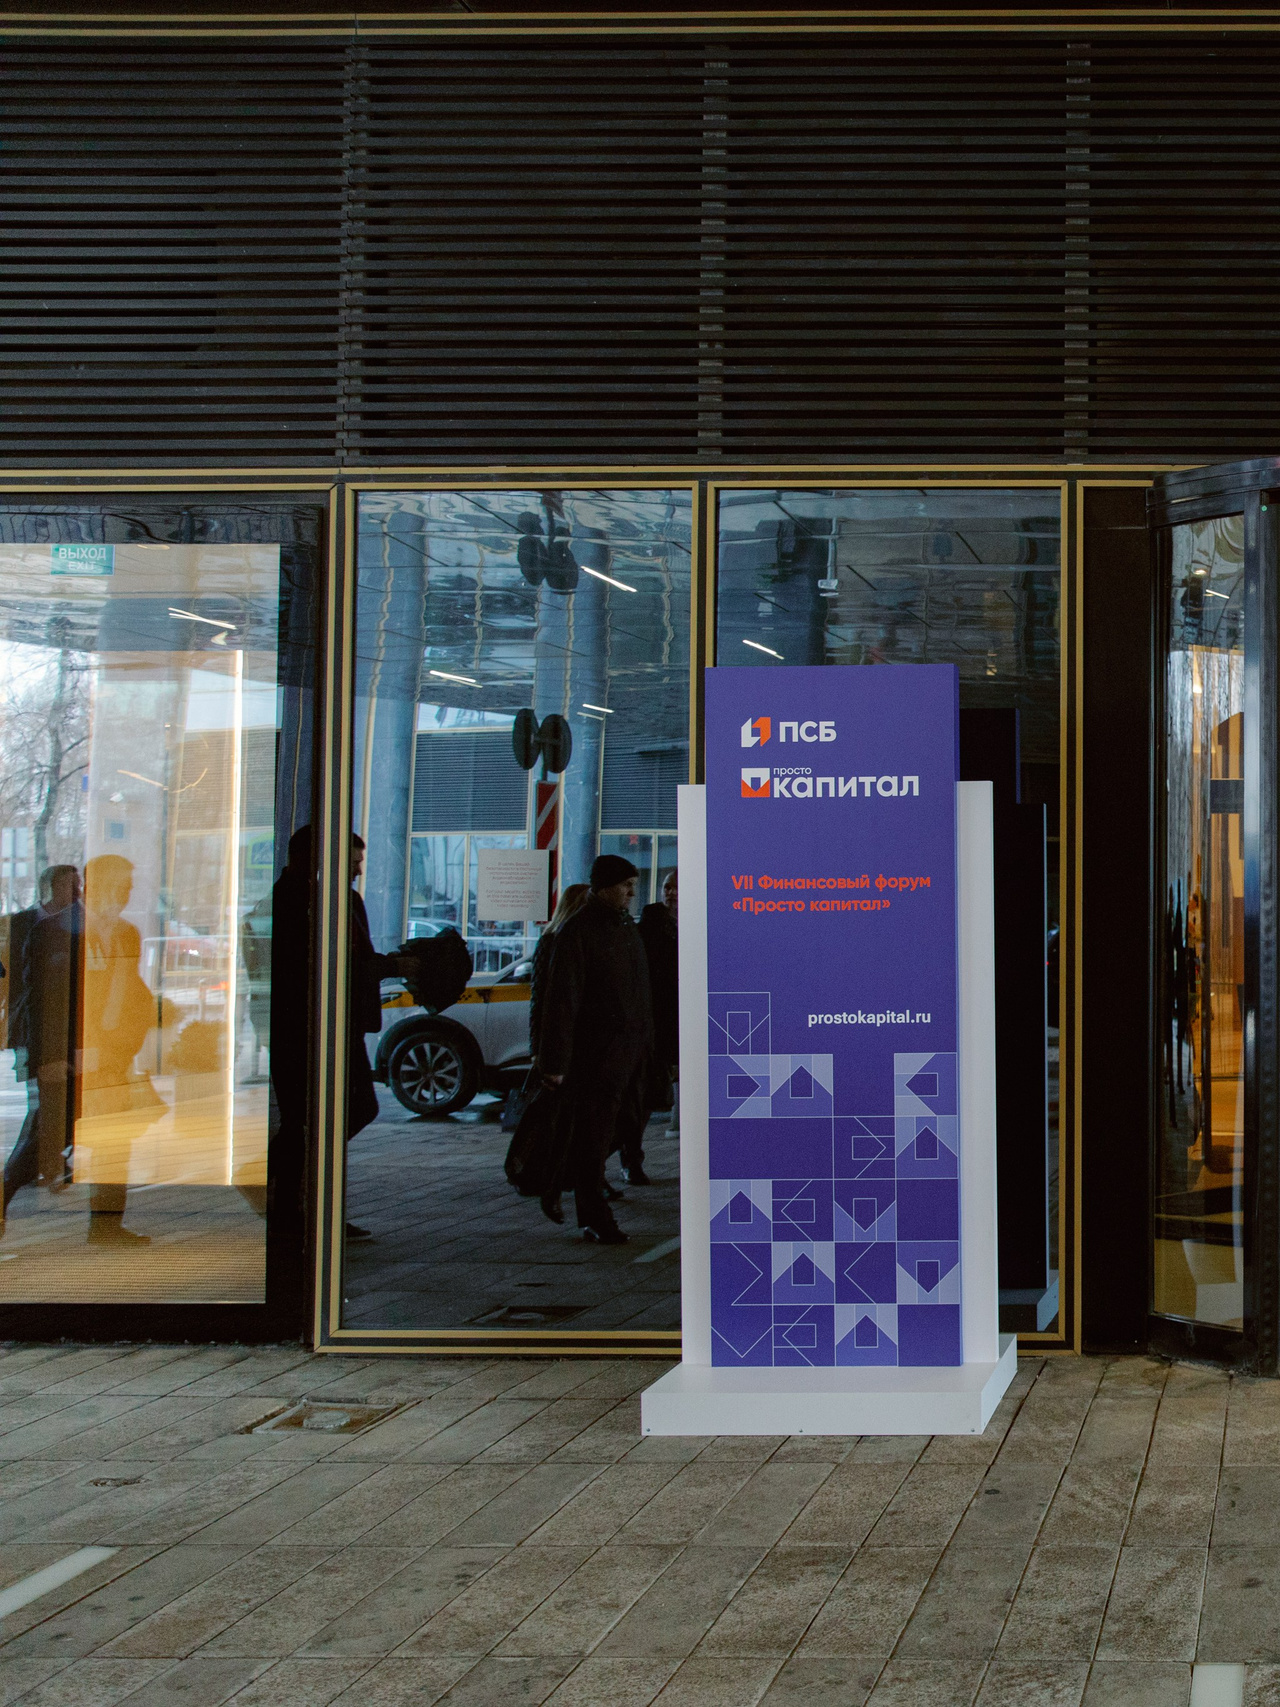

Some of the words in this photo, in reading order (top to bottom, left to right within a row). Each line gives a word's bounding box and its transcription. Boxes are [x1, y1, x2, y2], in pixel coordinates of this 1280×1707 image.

[58, 547, 107, 561] ВЫХОД
[68, 561, 96, 570] EXIT
[779, 721, 837, 743] ПСБ
[773, 767, 812, 775] просто
[774, 775, 920, 798] капитал
[731, 875, 753, 890] VII
[758, 874, 870, 891] Финансовый
[875, 874, 931, 891] форум
[732, 898, 806, 915] «Просто
[809, 898, 891, 912] капитал»
[807, 1010, 932, 1027] prostokapital.ru
